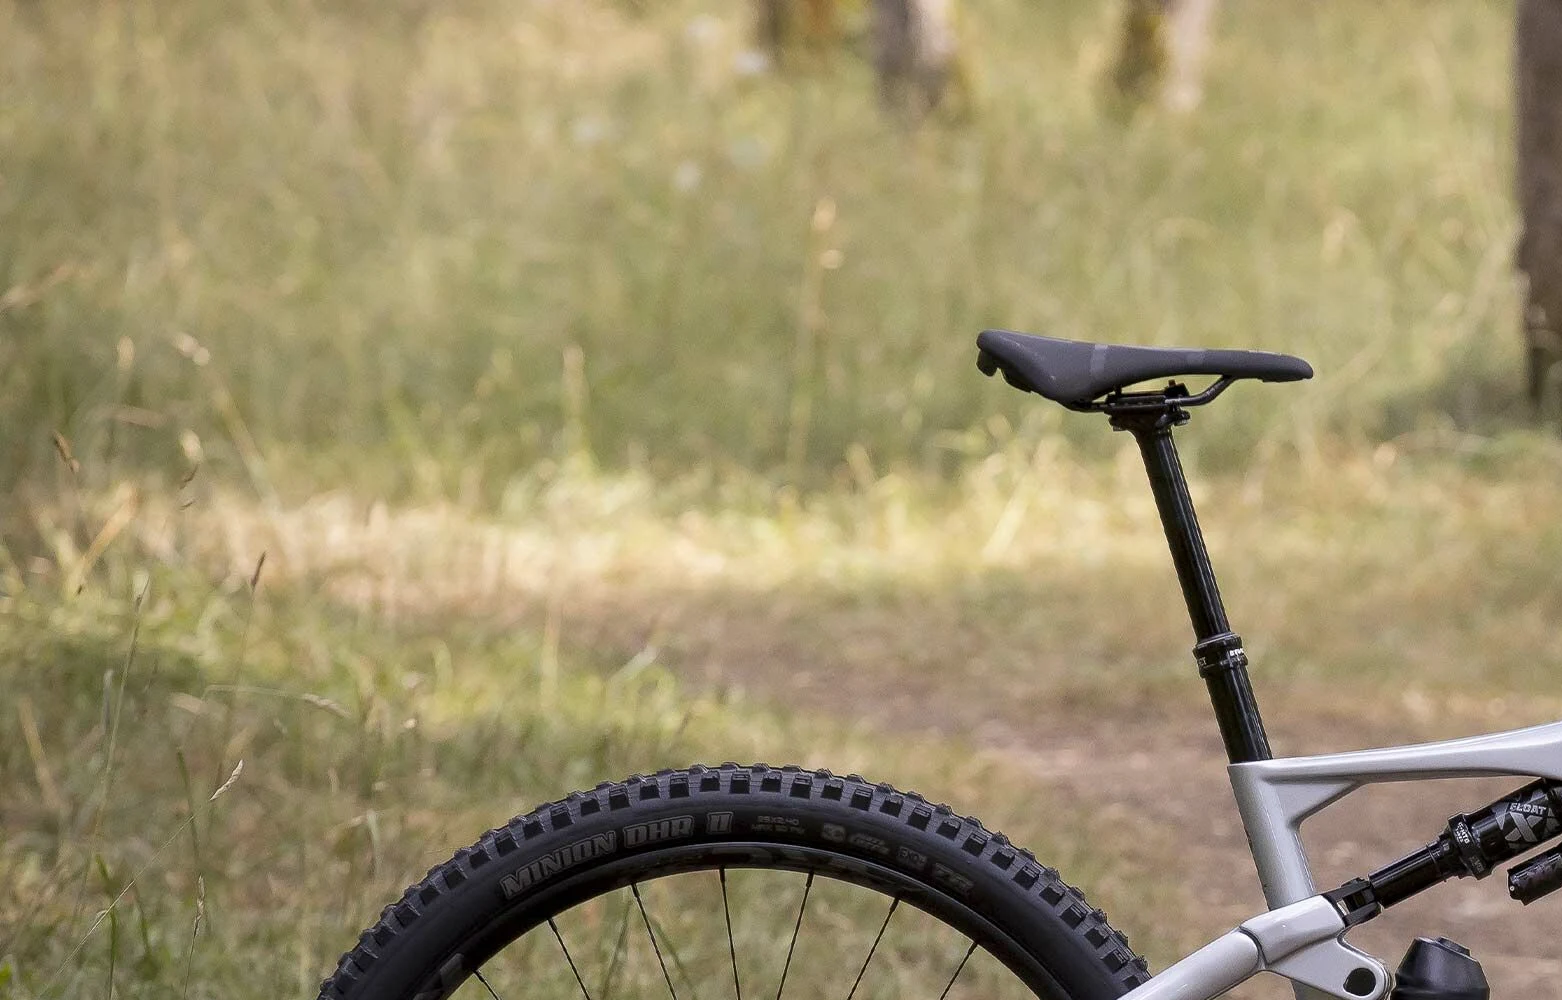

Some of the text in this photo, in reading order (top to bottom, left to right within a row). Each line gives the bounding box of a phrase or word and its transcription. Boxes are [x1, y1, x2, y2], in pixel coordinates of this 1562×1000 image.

[1509, 802, 1547, 816] FLOAT
[500, 831, 617, 898] MINION
[624, 815, 695, 848] DHR
